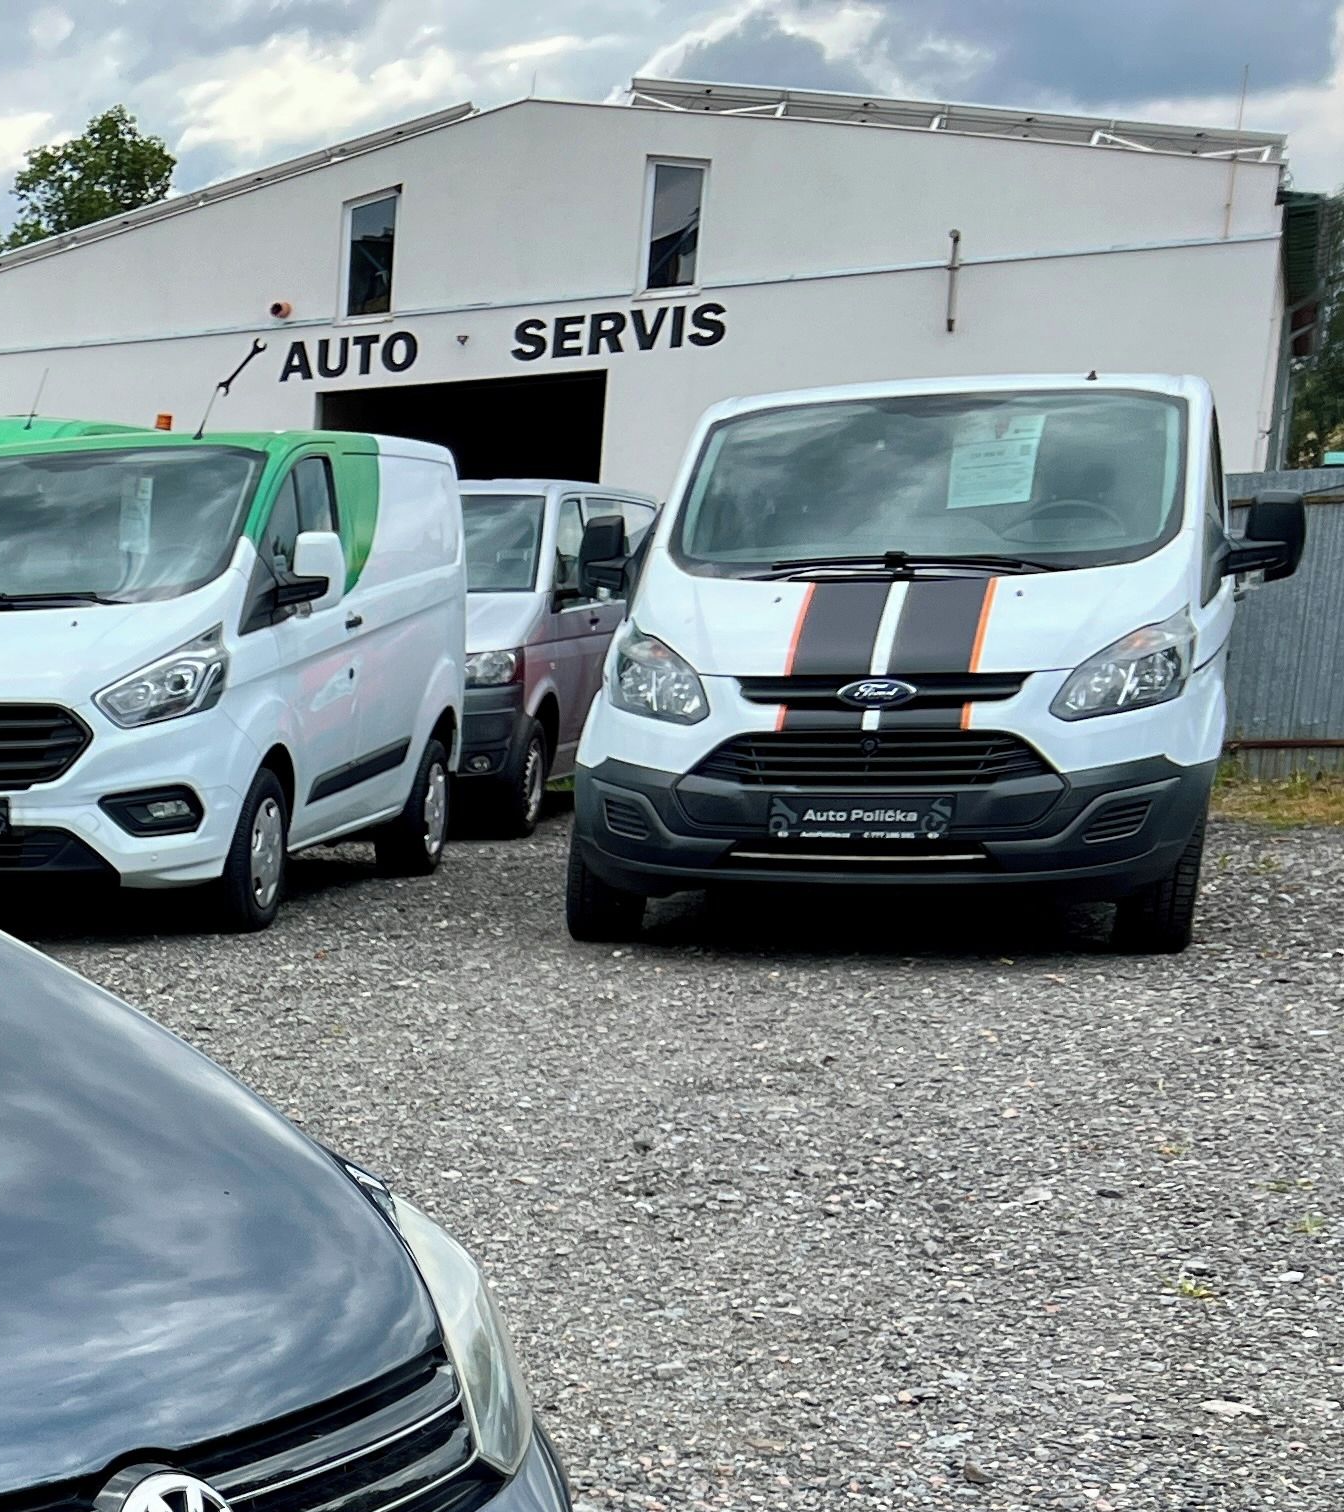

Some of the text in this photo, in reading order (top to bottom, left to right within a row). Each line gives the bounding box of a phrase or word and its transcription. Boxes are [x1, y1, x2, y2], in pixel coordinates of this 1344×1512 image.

[279, 303, 727, 382] AUTO SERVIS
[803, 809, 918, 822] Auto Polička
